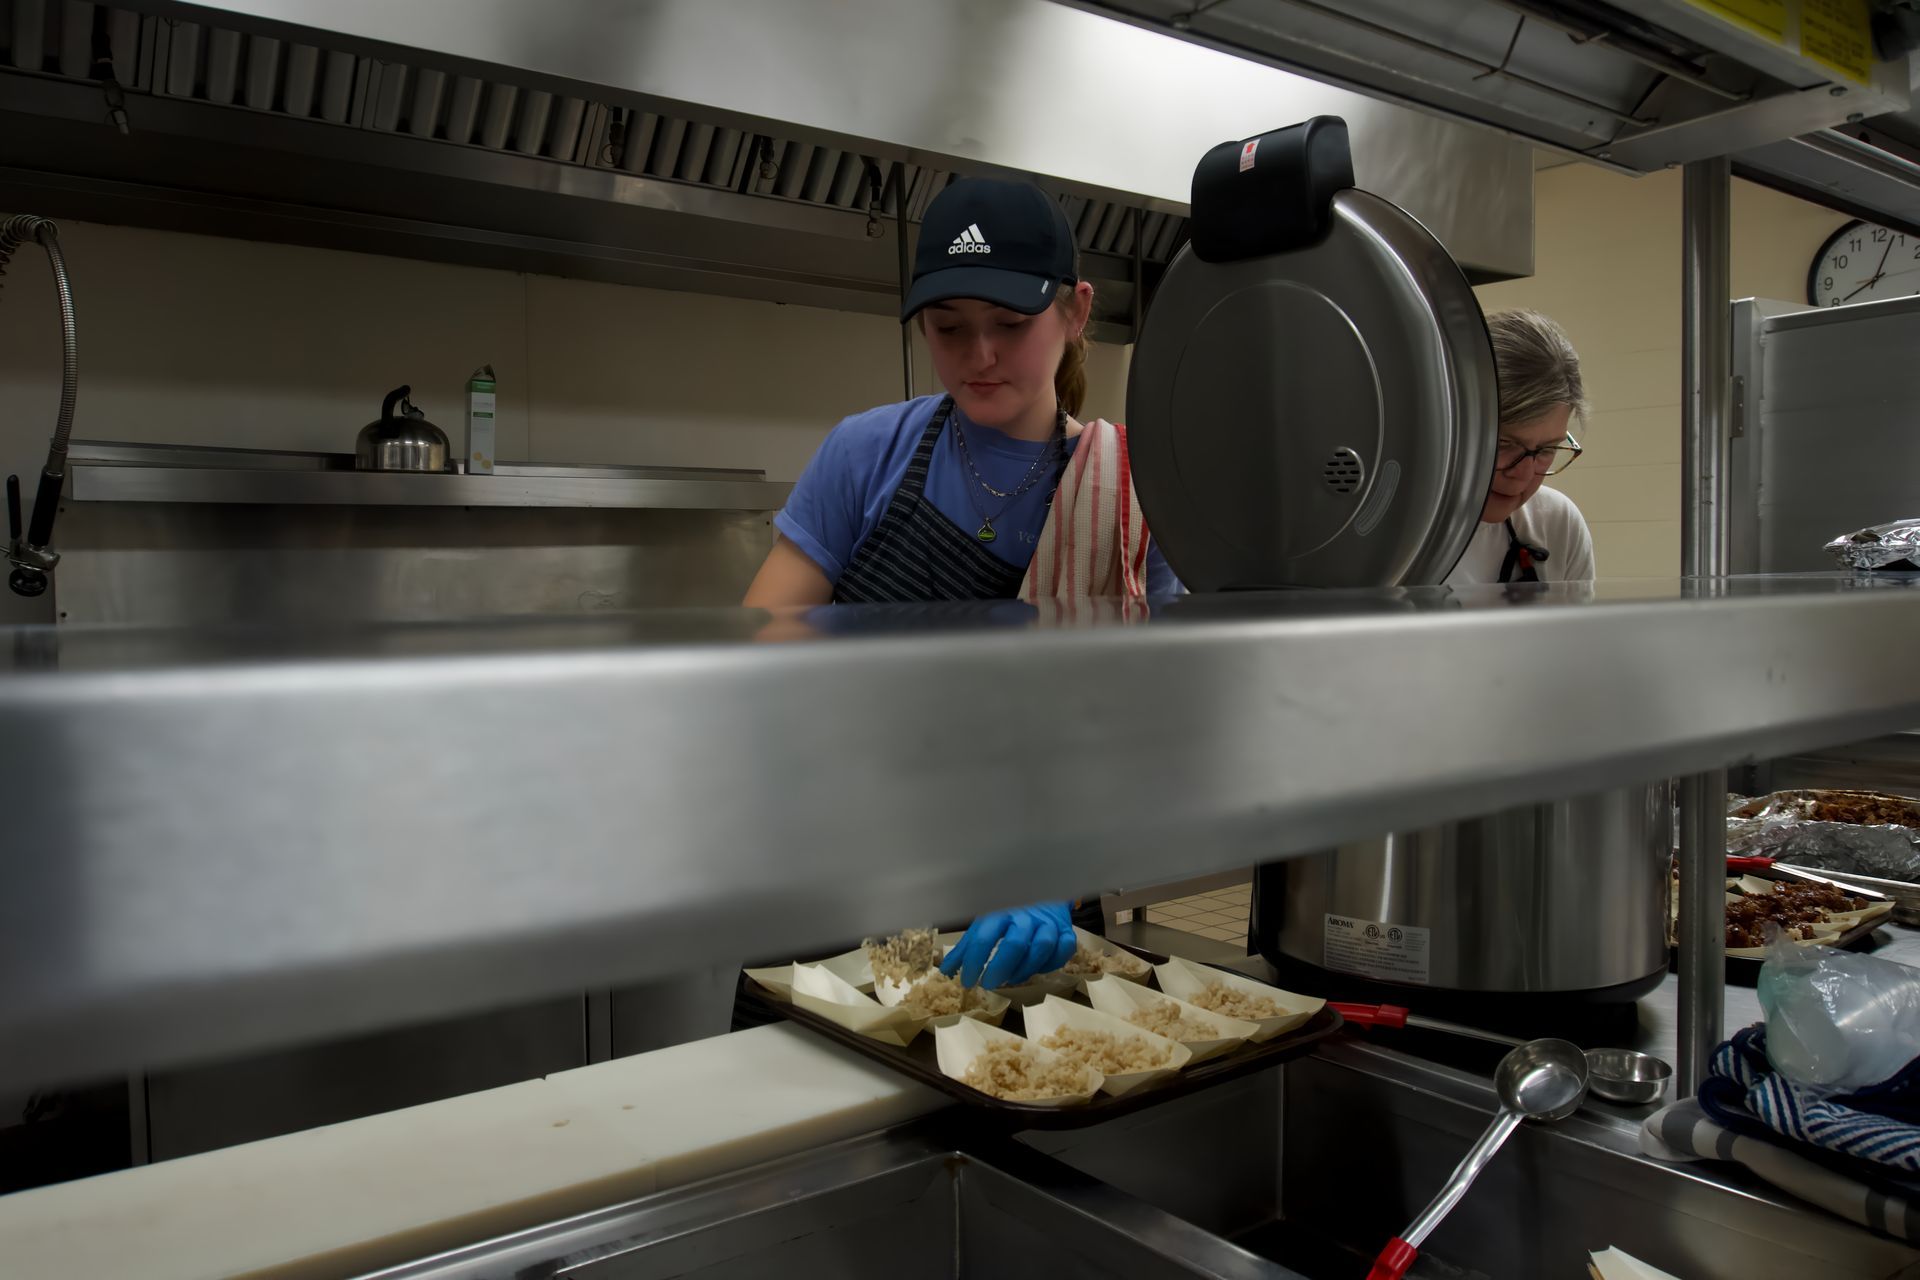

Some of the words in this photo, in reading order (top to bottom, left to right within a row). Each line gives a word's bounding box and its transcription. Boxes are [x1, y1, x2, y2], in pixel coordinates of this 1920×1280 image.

[1871, 228, 1887, 242] 12
[1899, 234, 1905, 247] 1
[948, 241, 992, 255] adidas
[1849, 239, 1862, 252] 11
[1832, 255, 1848, 269] 10
[1824, 277, 1833, 291] 9
[1328, 916, 1354, 929] AROMA
